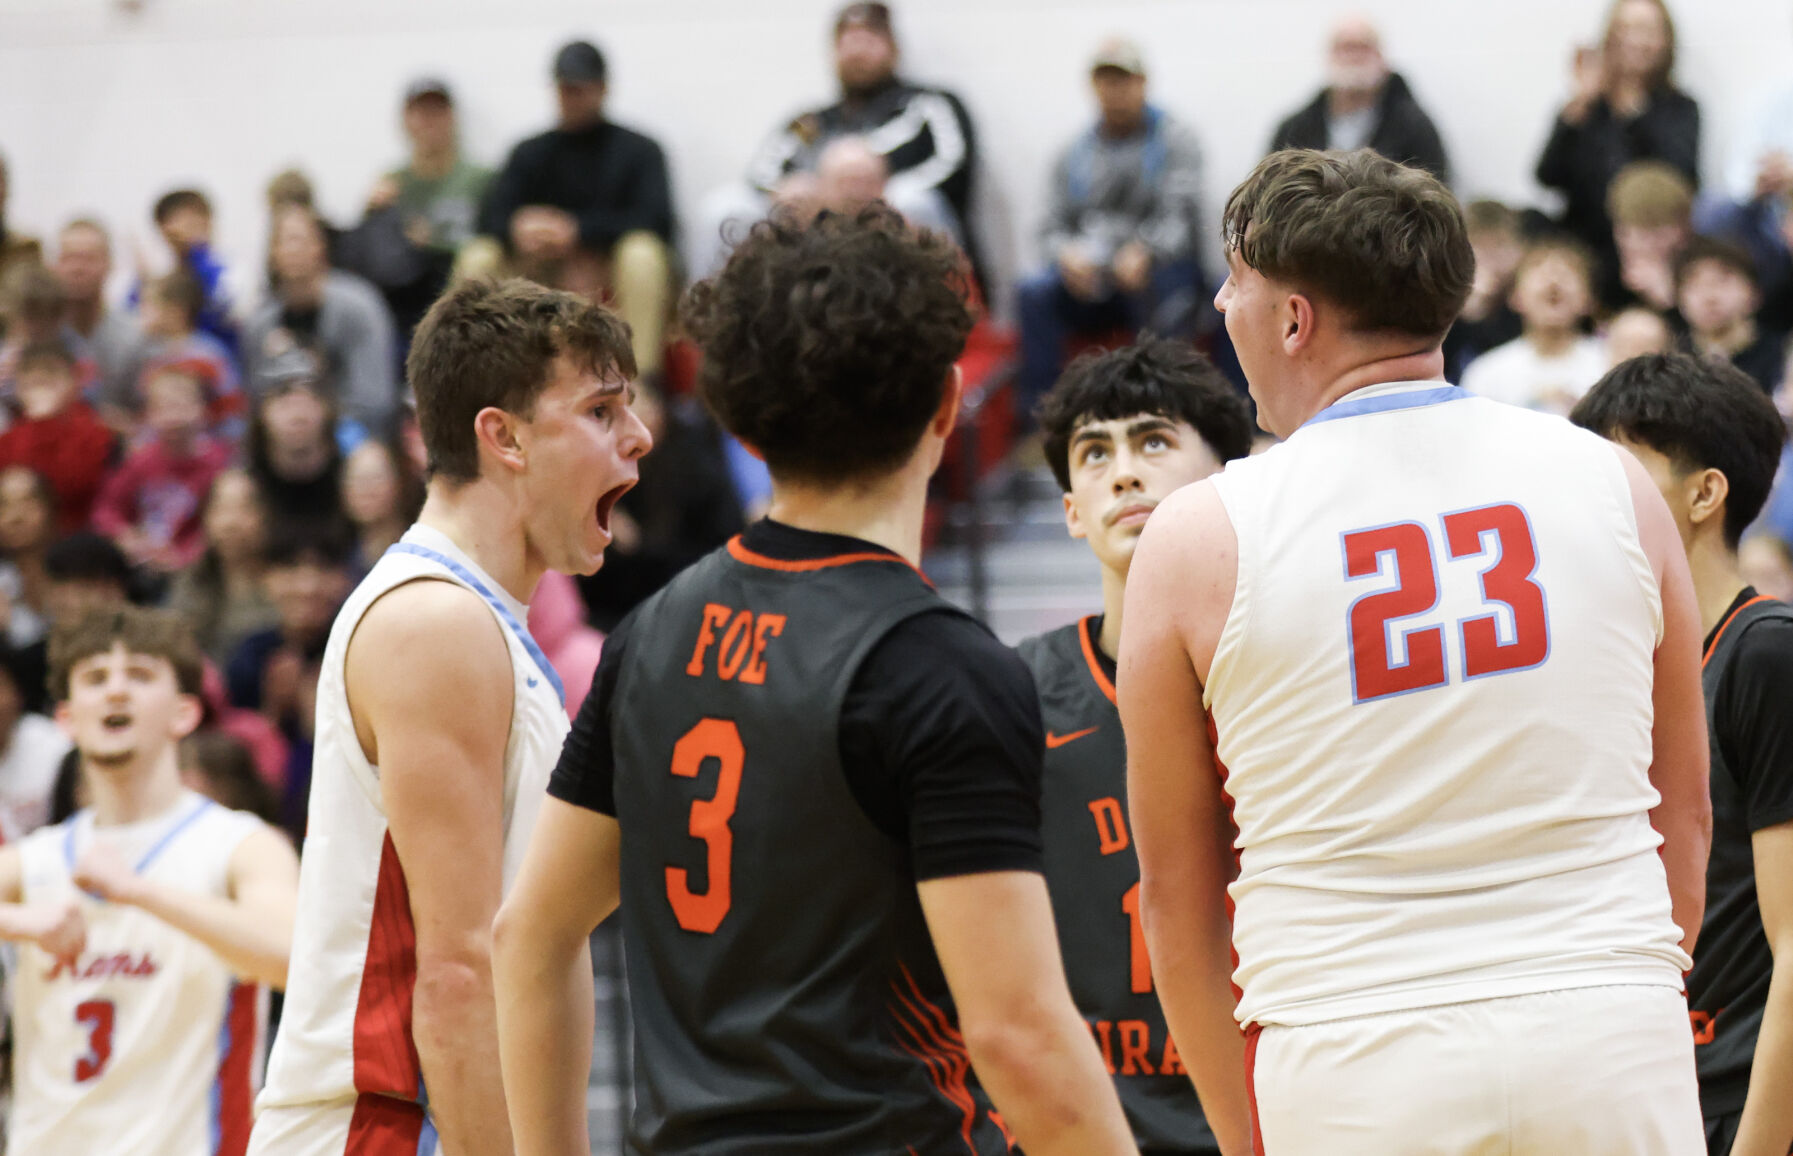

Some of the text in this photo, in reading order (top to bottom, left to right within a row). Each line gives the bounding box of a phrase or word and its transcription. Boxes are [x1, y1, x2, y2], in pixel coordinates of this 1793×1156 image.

[686, 603, 788, 685] FOE
[1339, 500, 1551, 705] 23
[664, 717, 746, 935] 3
[74, 998, 115, 1083] 3
